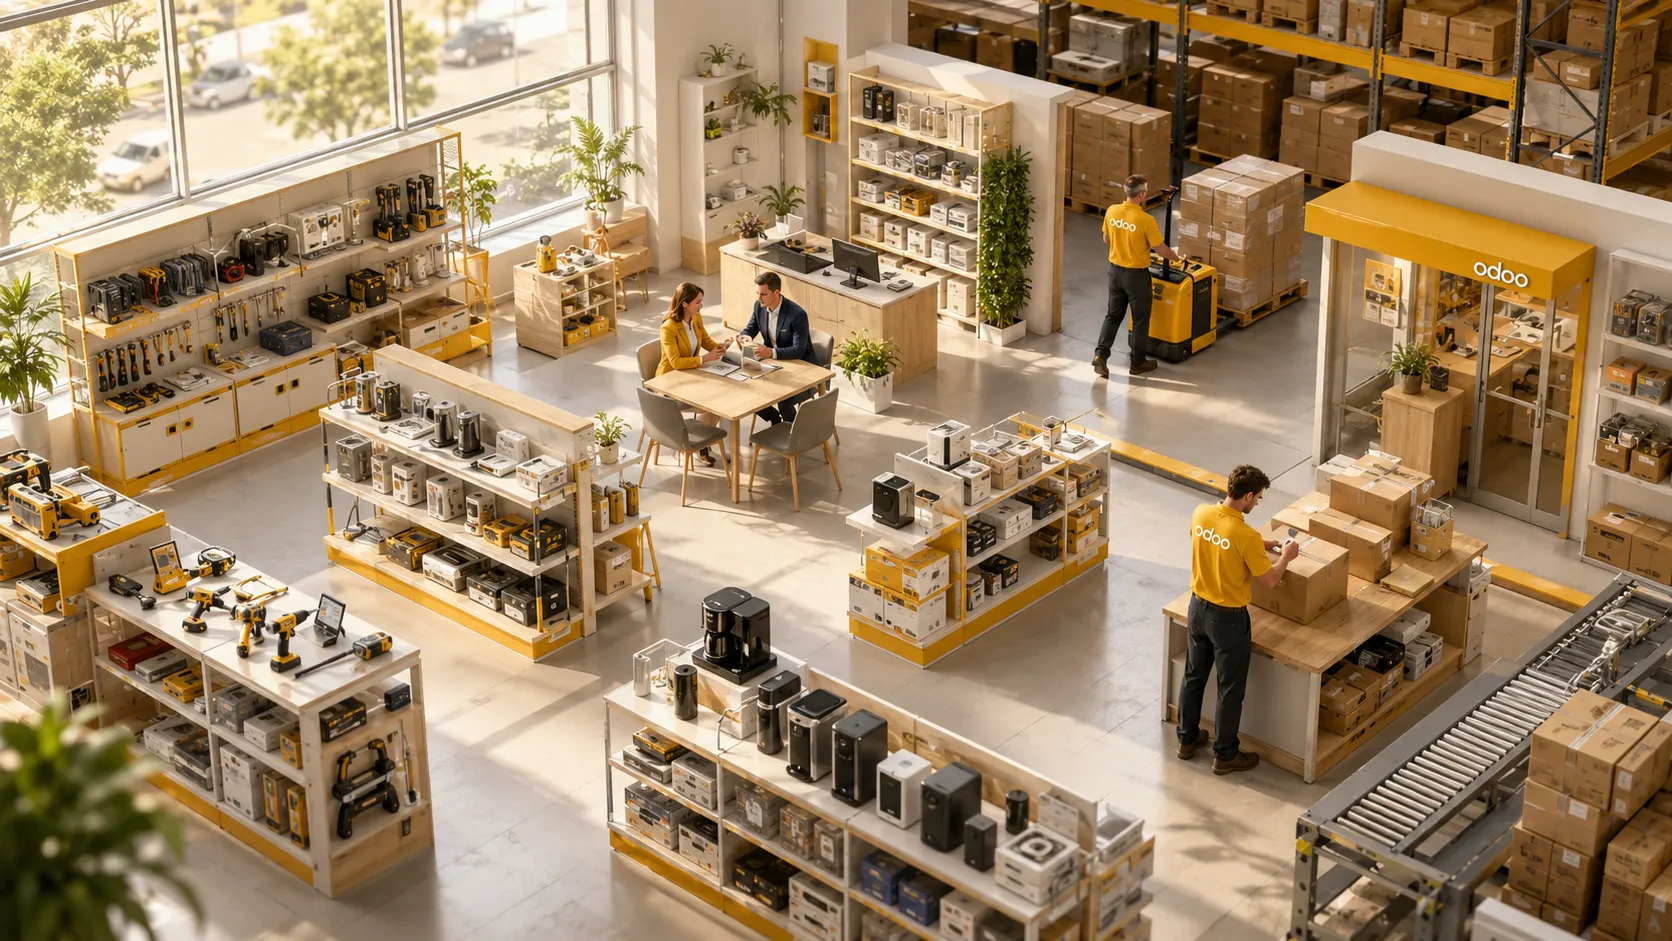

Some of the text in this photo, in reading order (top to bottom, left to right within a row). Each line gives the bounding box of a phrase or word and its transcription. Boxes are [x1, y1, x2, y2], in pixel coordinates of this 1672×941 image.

[1109, 217, 1137, 232] odoo
[1473, 261, 1529, 288] odoo
[1194, 524, 1231, 550] odoo
